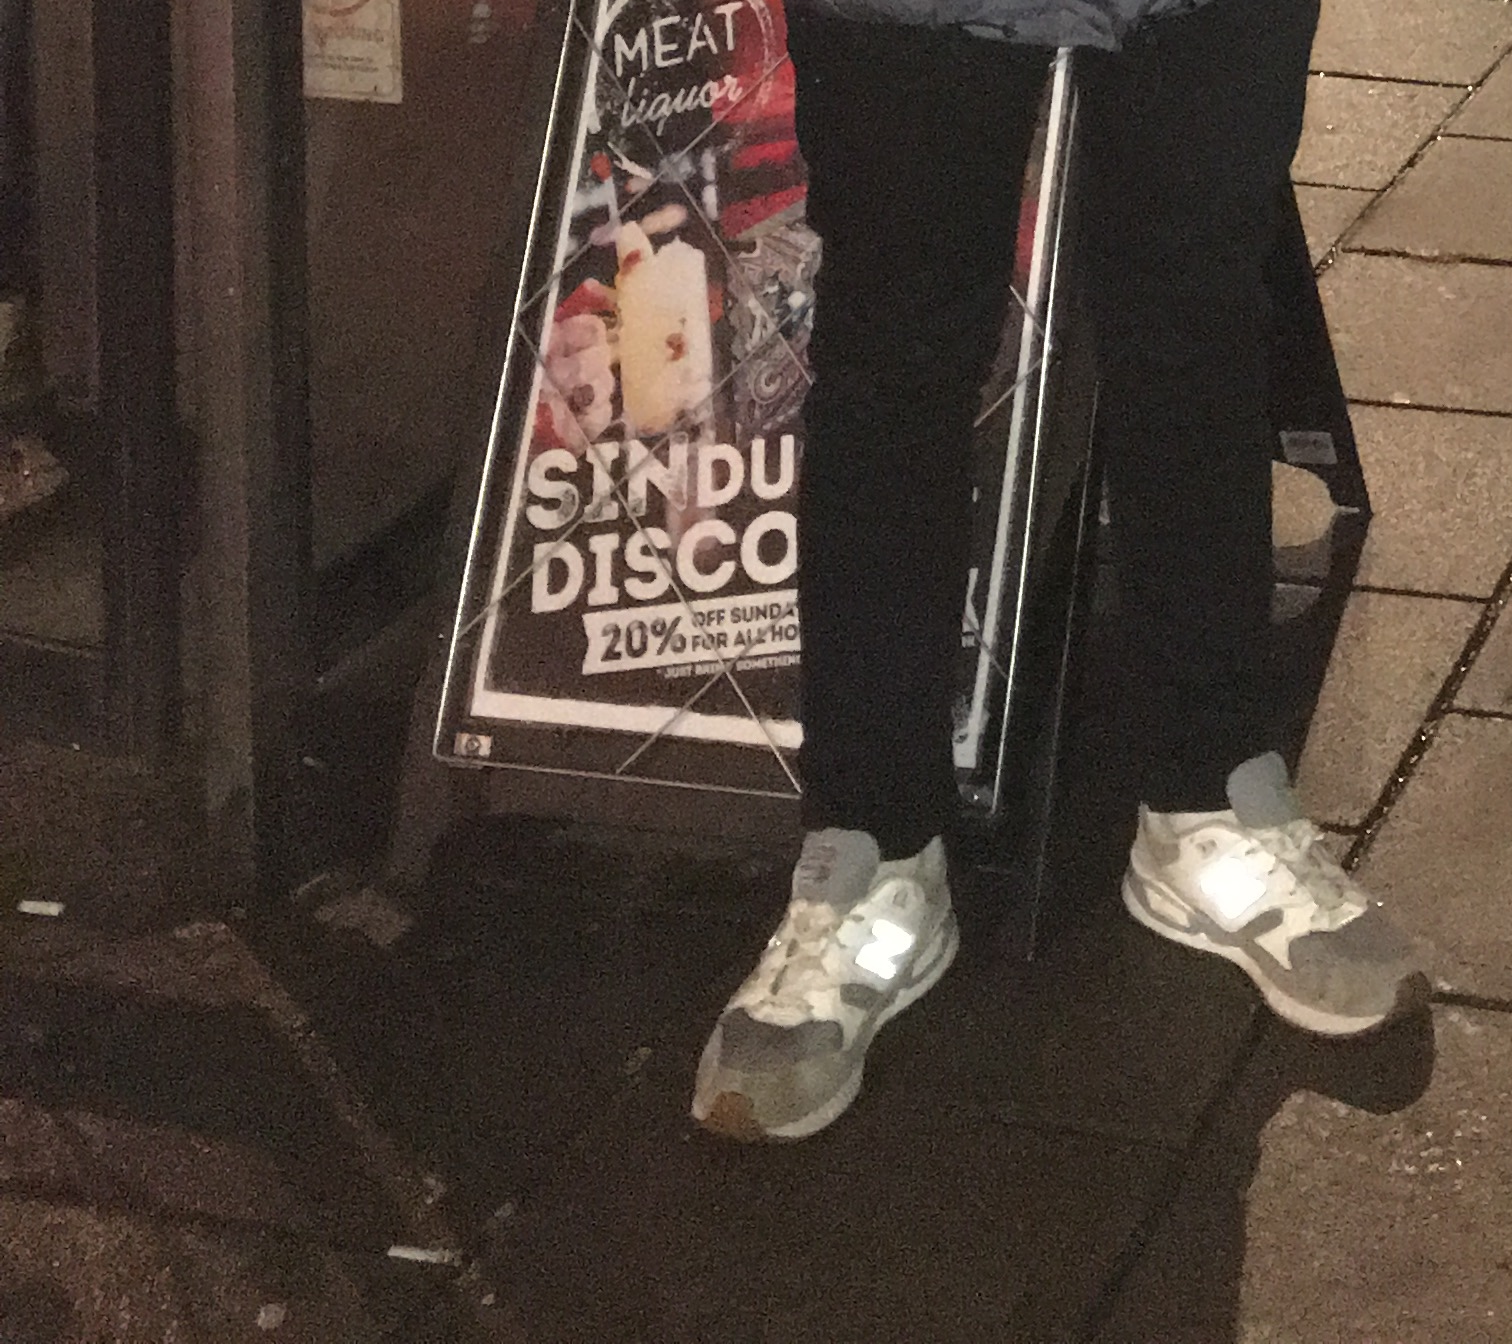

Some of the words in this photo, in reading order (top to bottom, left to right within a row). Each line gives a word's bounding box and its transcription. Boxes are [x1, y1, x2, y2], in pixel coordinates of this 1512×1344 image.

[613, 0, 744, 78] MEAT
[531, 510, 798, 614] DISCO
[691, 608, 726, 628] OFF
[730, 601, 798, 624] SUNDA
[600, 616, 687, 662] 20%
[691, 631, 728, 653] FOR
